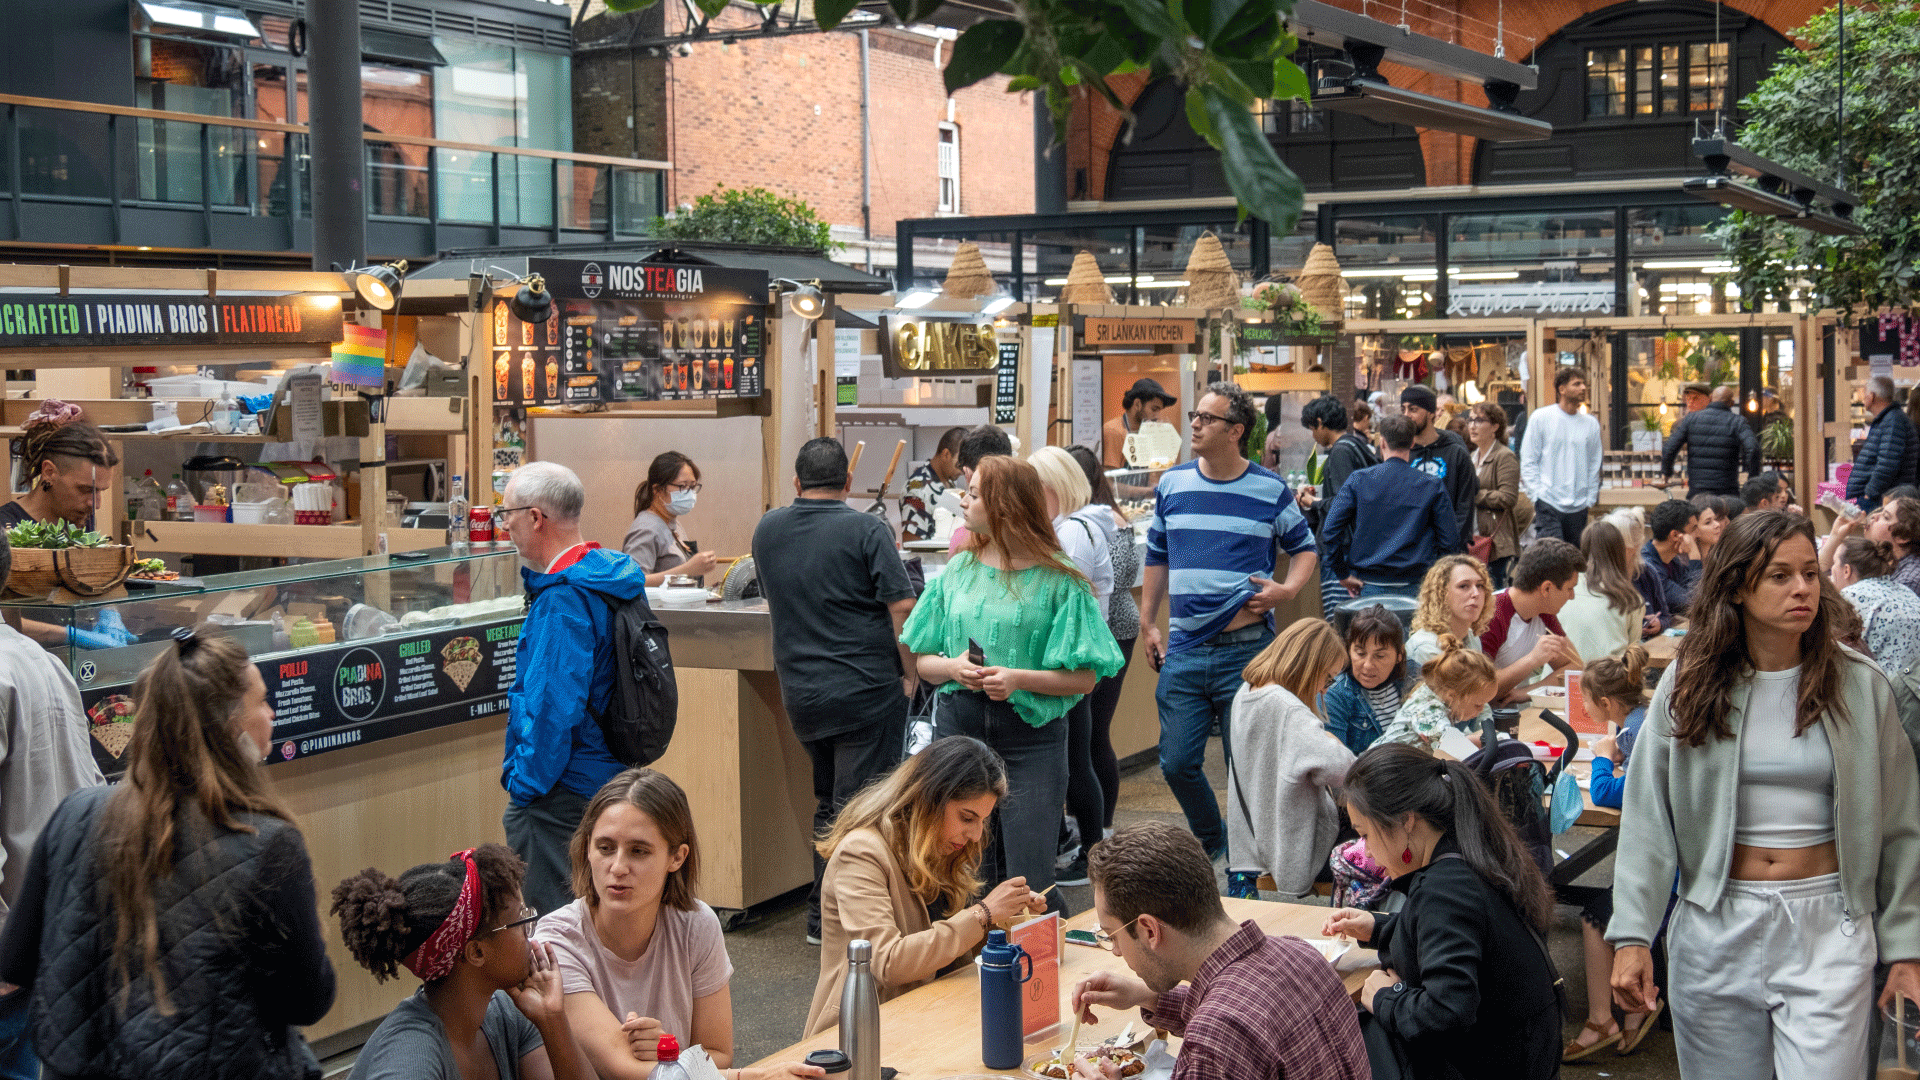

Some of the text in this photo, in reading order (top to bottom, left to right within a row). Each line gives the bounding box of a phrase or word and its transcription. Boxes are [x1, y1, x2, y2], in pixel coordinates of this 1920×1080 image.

[609, 265, 704, 293] NOSTEAGIA
[0, 304, 80, 334] CRAFTED
[97, 304, 165, 334] PIADINA
[168, 304, 208, 334] BROS
[223, 305, 301, 333] FLATBREAD
[1098, 324, 1183, 341] SRI LANKAN KITCHEN
[899, 321, 999, 370] CAKES
[486, 623, 522, 642] VEGETARI
[399, 639, 431, 658] GRILLED
[280, 661, 308, 679] POLLO
[339, 662, 382, 686] PIADINA
[342, 685, 375, 708] BROS.
[470, 701, 497, 717] E-MAIL:
[300, 729, 361, 754] @PIADINABROS
